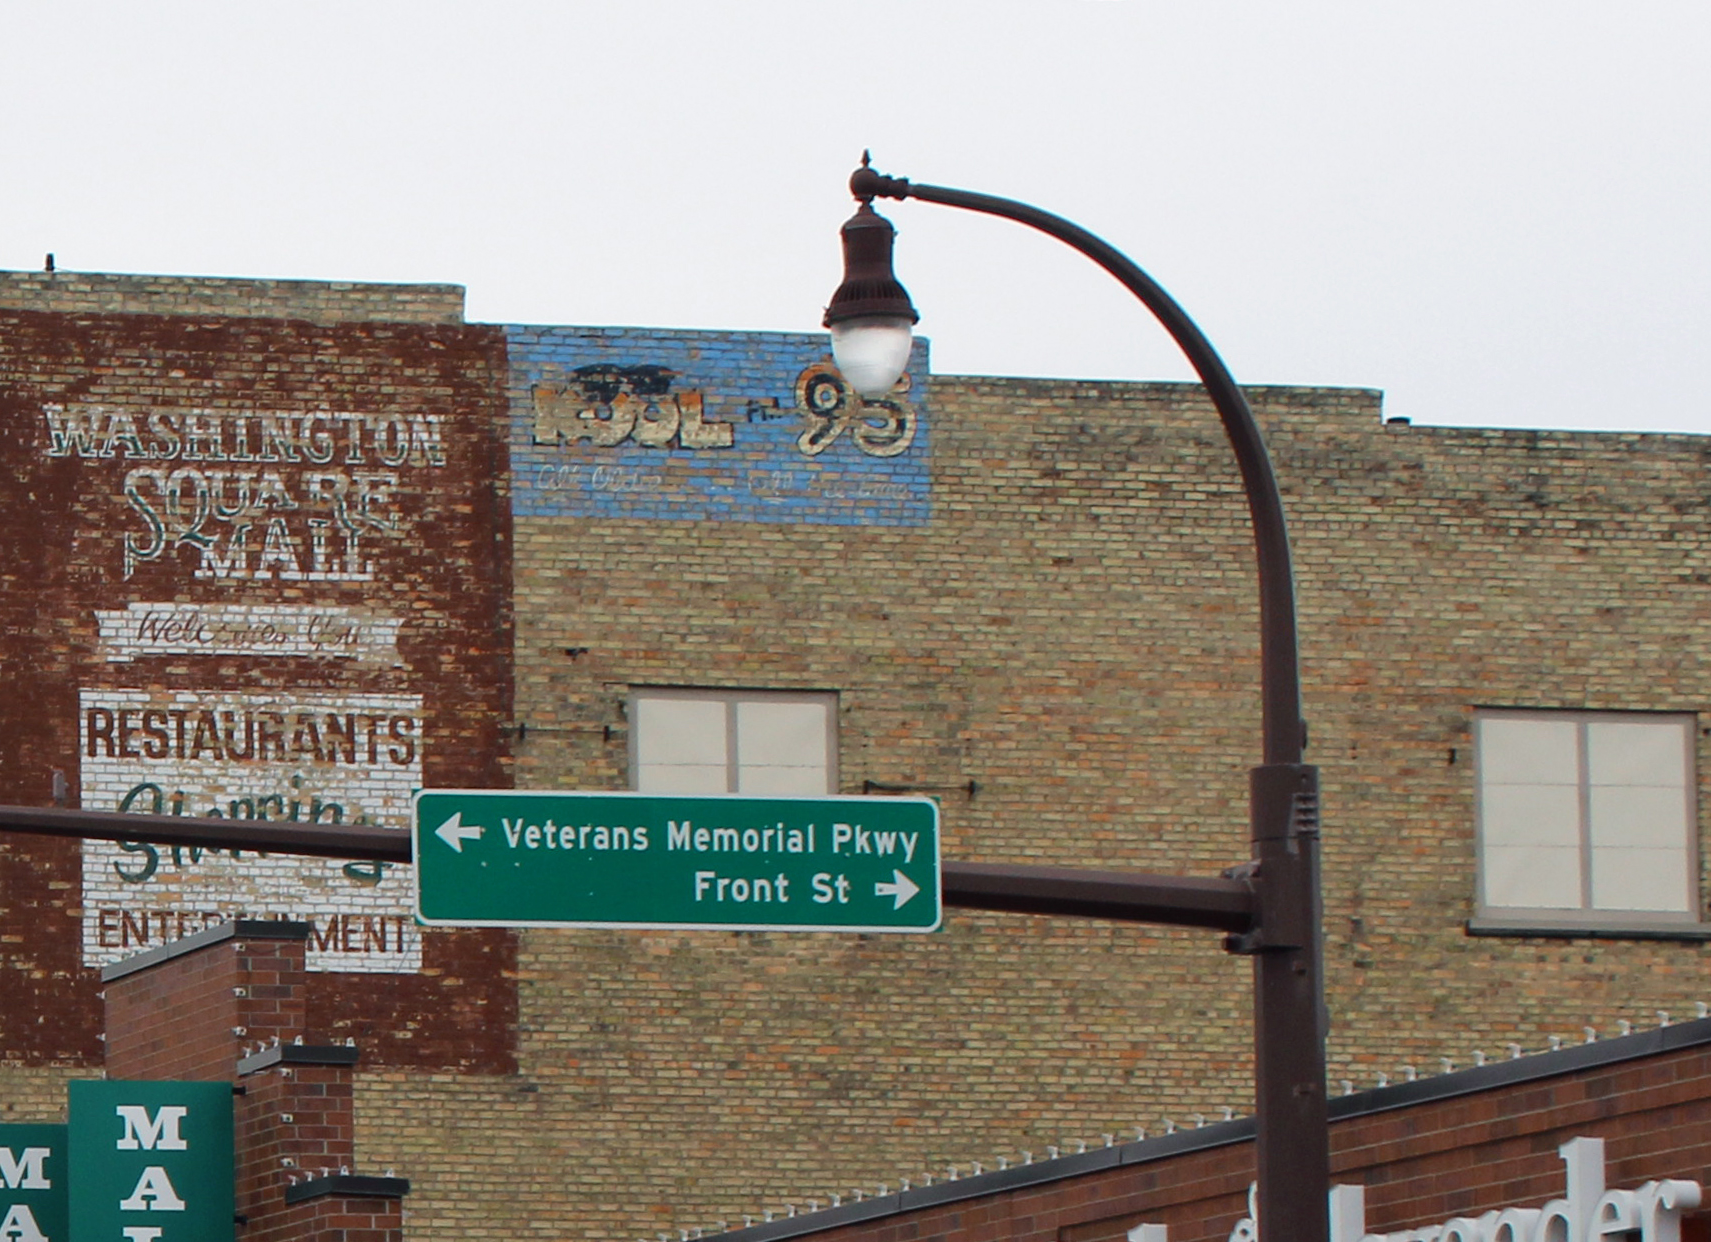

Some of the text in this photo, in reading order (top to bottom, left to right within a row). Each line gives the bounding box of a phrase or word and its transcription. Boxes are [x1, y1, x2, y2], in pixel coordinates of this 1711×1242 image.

[42, 403, 447, 468] WASHINGTON
[124, 466, 400, 582] SQUARE
[194, 517, 376, 582] MALL
[85, 706, 416, 766] RESTAURANTS
[500, 817, 919, 863] Veterans Memorial Pkwy
[694, 870, 851, 904] Front St
